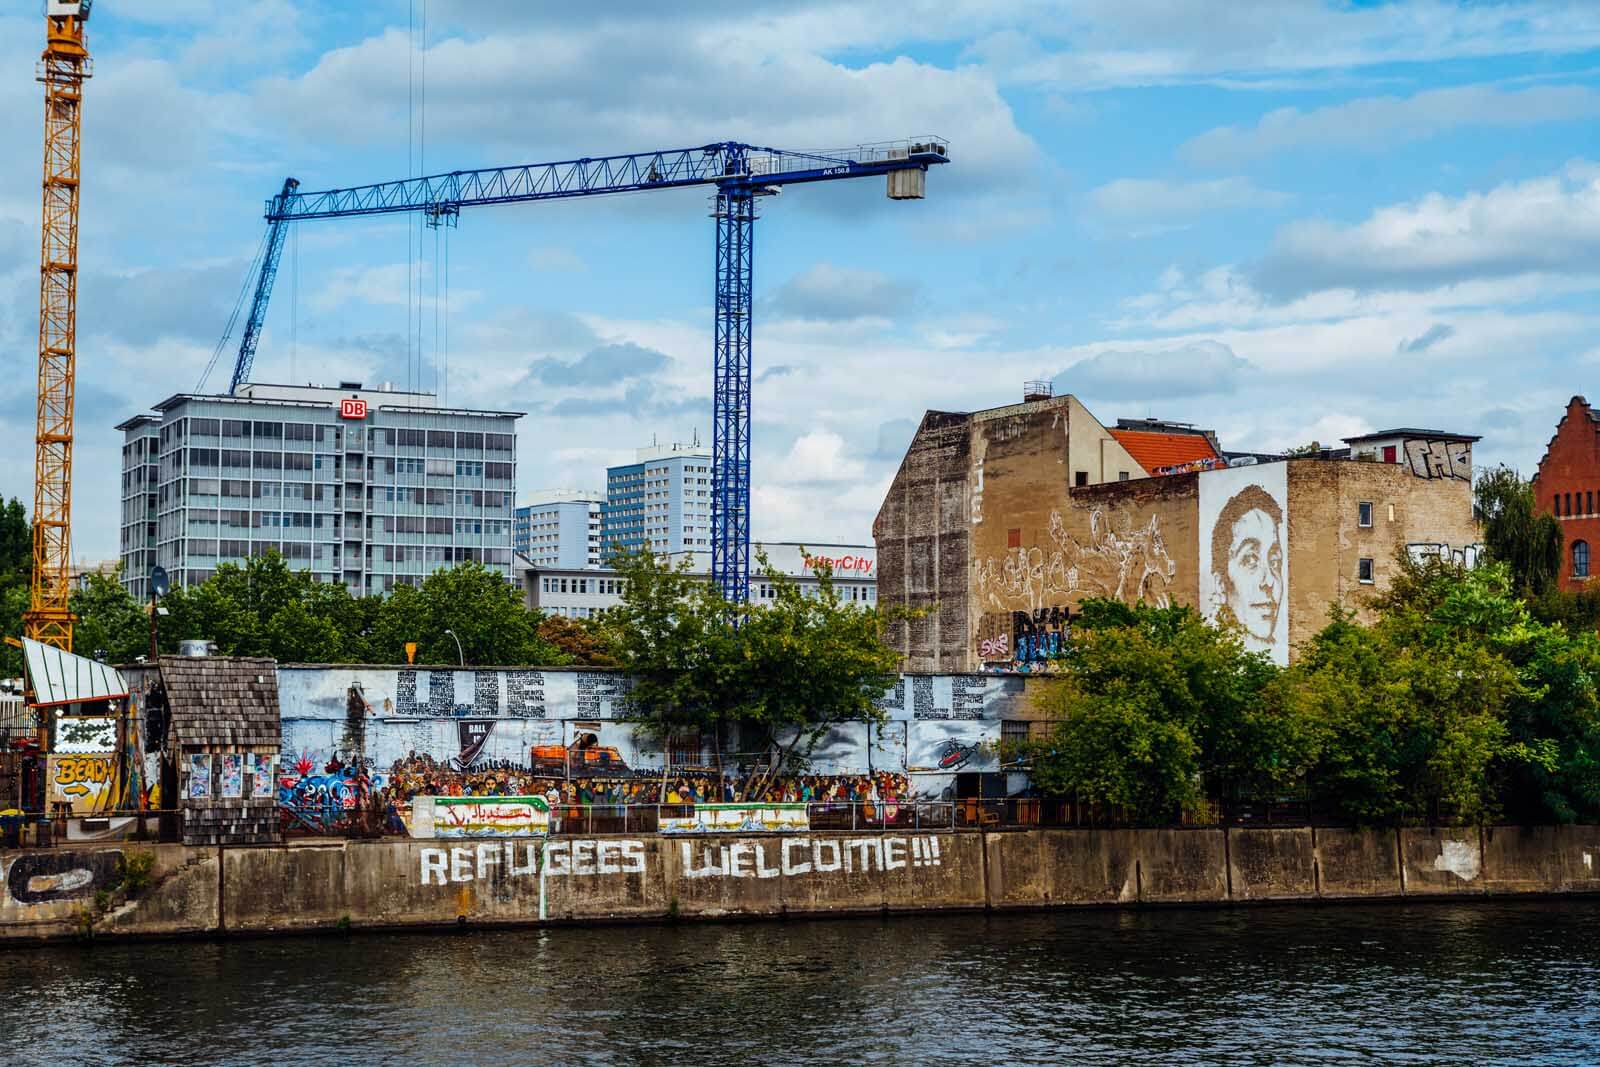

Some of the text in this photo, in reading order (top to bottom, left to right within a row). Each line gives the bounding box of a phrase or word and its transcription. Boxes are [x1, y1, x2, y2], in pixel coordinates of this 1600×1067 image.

[344, 402, 364, 416] DB
[468, 724, 486, 734] BALL
[55, 759, 117, 785] BEACH
[420, 840, 646, 885] REFUGEES
